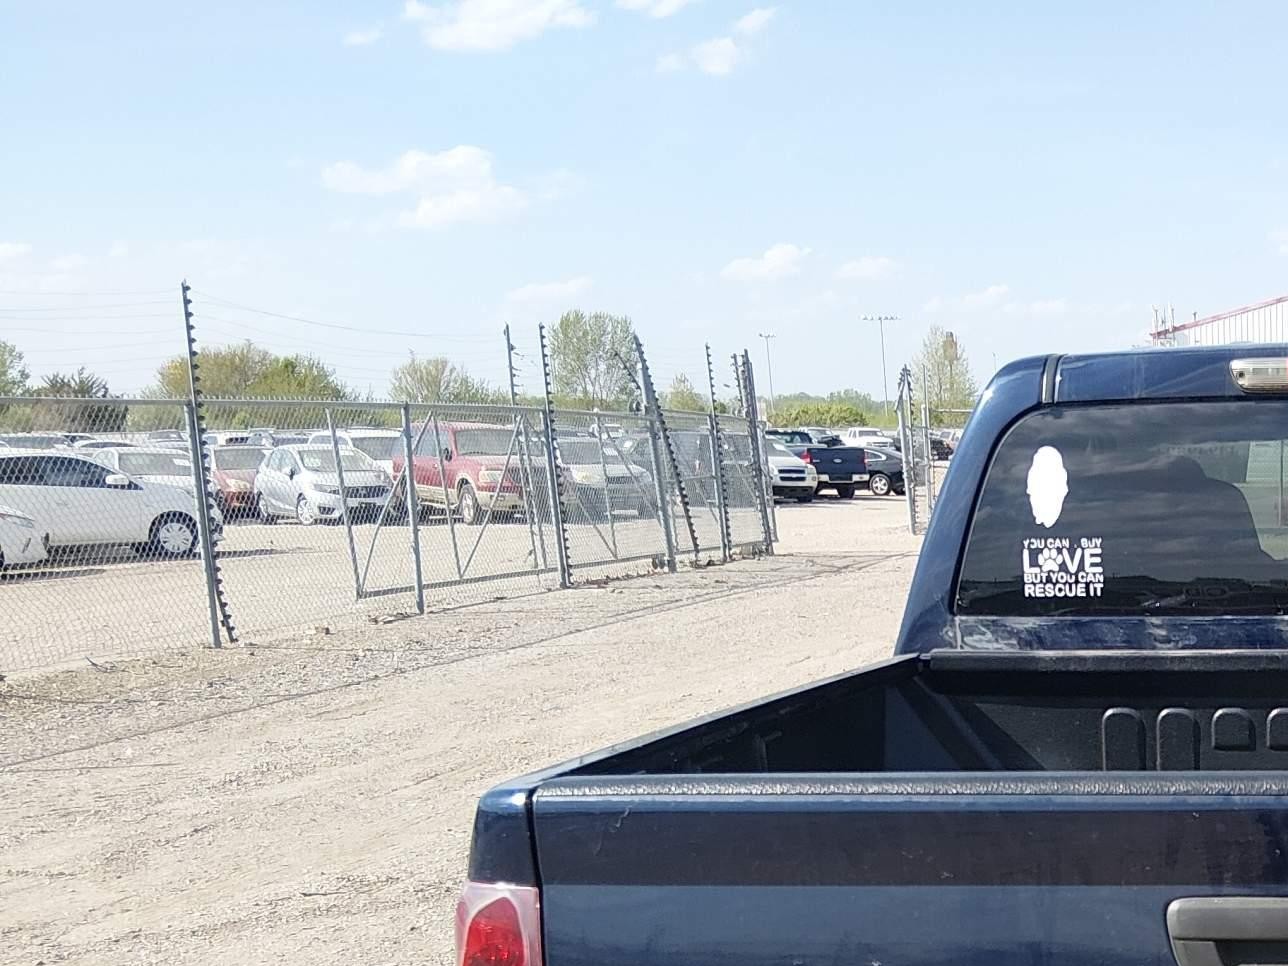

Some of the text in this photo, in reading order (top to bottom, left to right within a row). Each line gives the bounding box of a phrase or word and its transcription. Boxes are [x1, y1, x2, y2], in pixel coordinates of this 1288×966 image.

[1023, 538, 1045, 549] YOU
[1080, 537, 1102, 548] BUY
[1024, 571, 1104, 583] BUT YOU CAN
[1024, 582, 1104, 597] RESCUE IT
